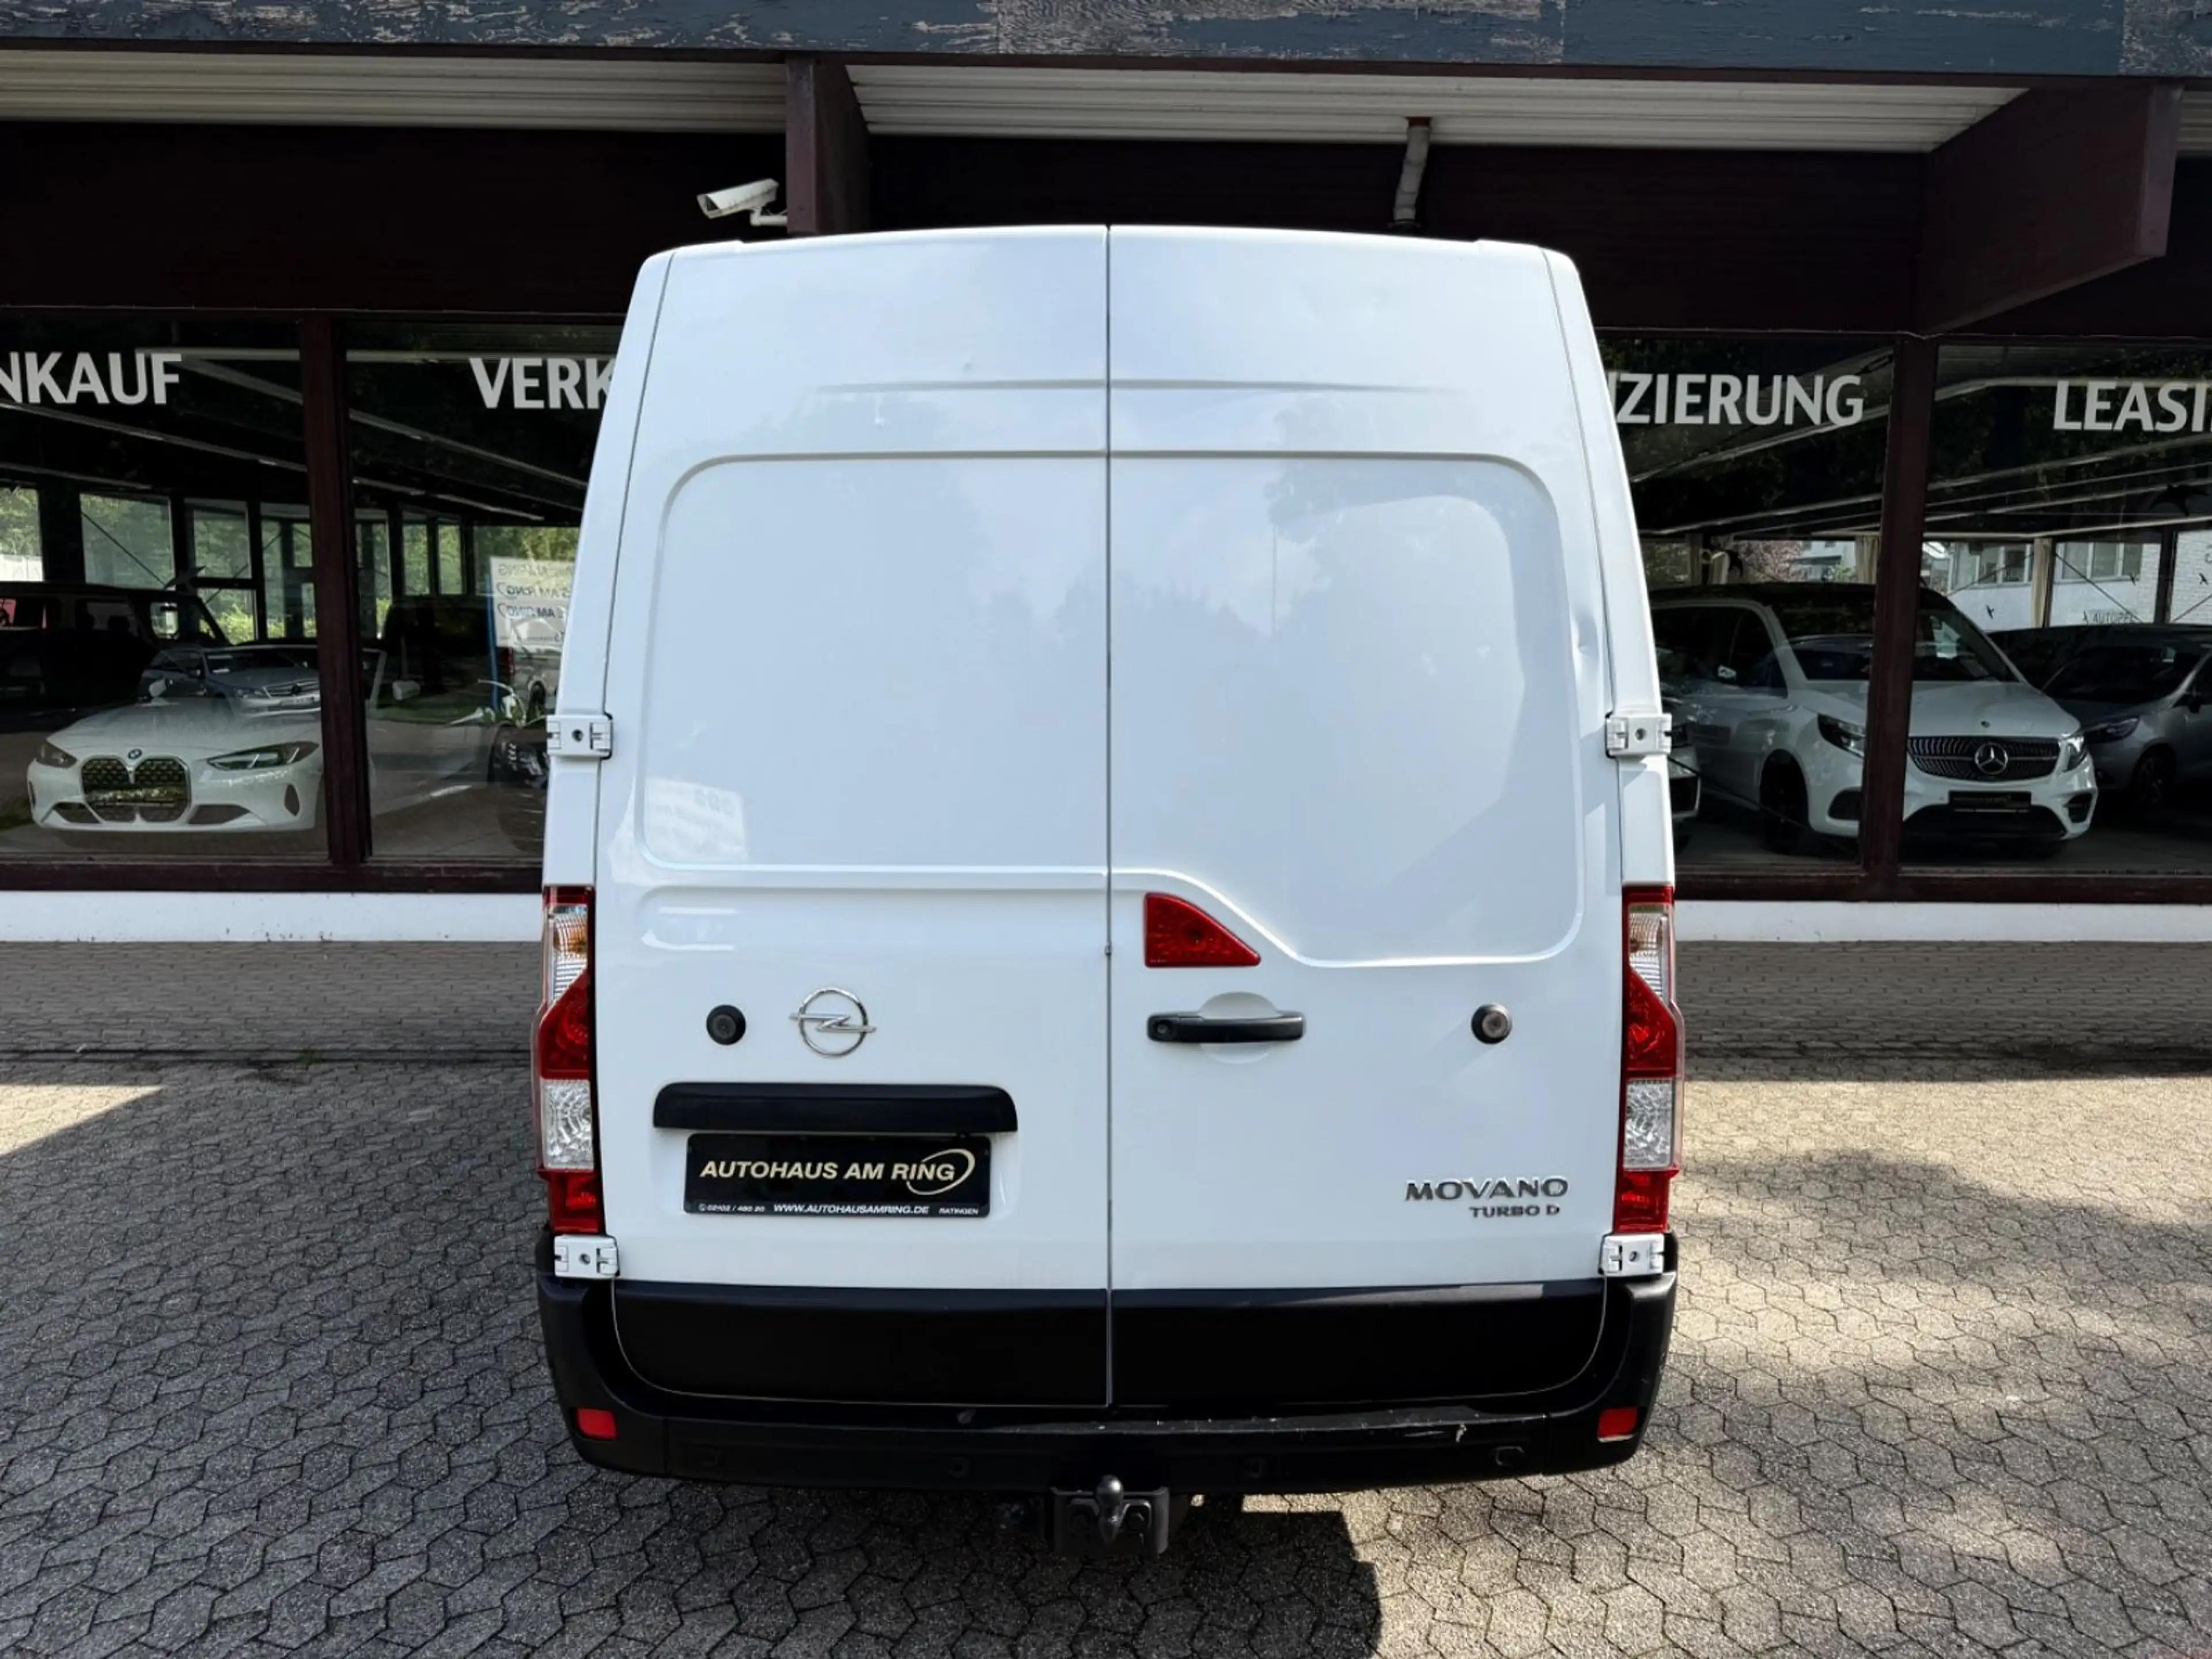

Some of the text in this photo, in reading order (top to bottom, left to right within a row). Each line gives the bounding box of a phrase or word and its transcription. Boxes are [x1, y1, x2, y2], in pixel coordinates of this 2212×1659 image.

[468, 357, 616, 409] VERK
[2053, 380, 2212, 433] LEASI
[699, 1161, 956, 1181] AUTOHAUS AM RING
[1405, 1177, 1569, 1201] MOVANO
[774, 1203, 929, 1214] WWW.AUTOHAUSAMRING.DE
[1469, 1204, 1561, 1218] TURBO D
